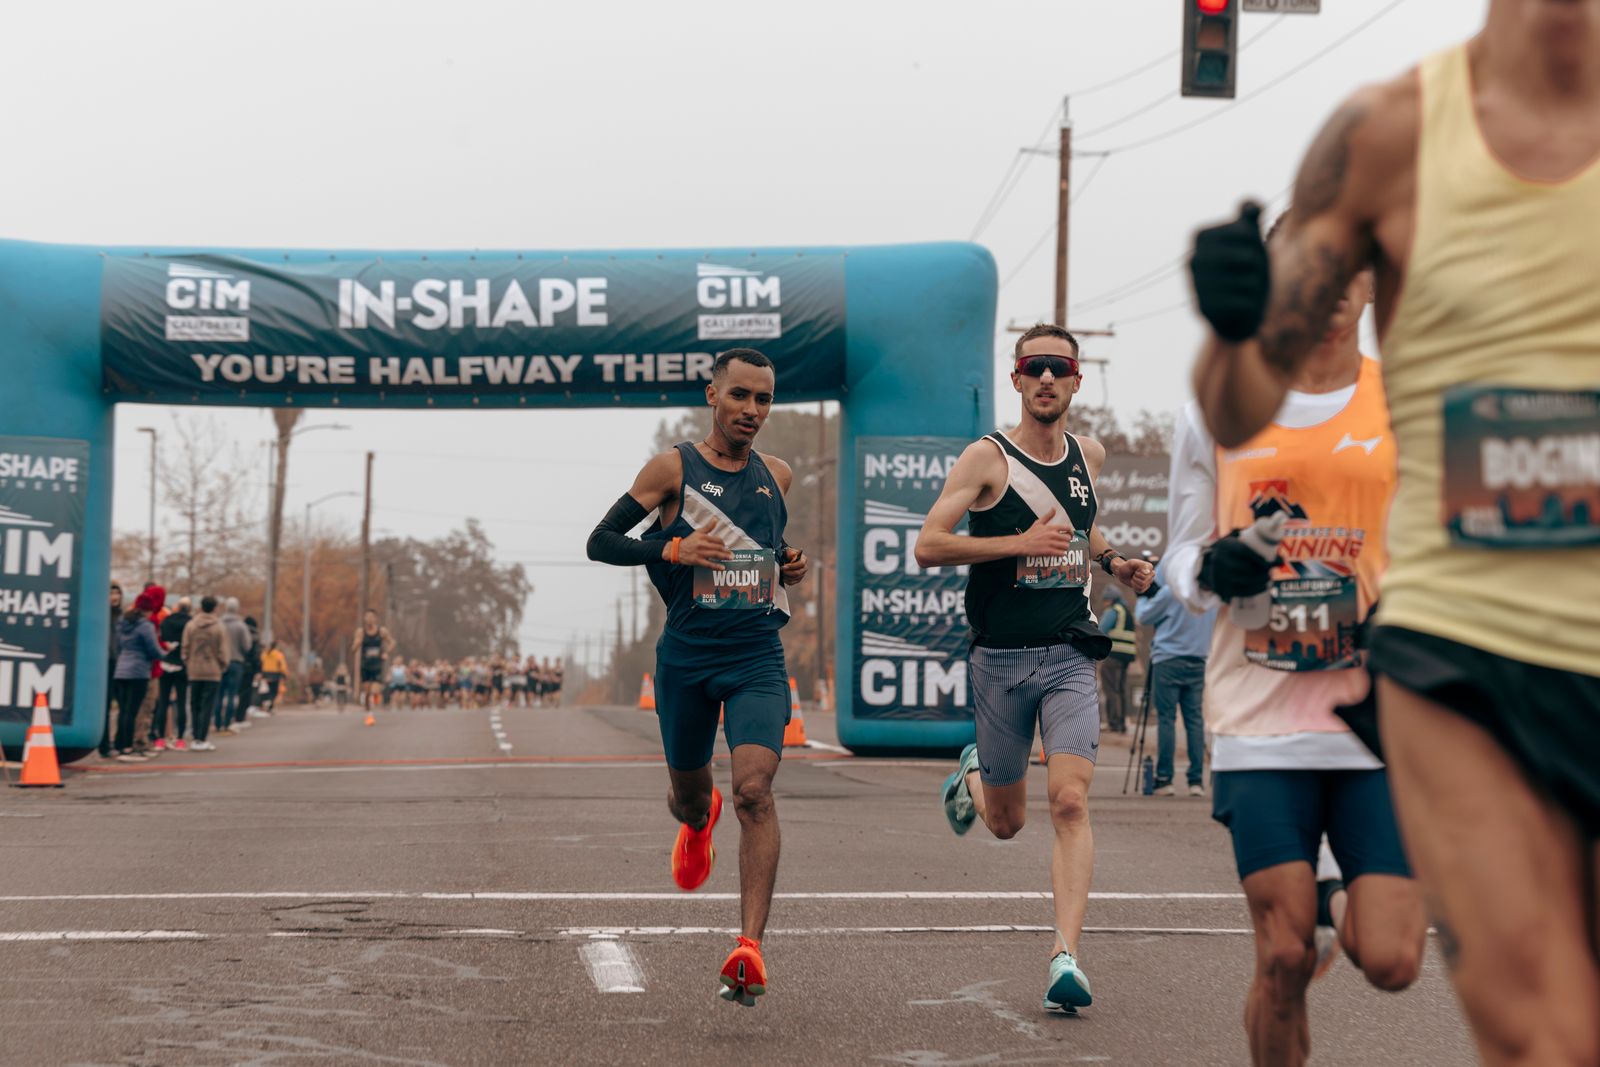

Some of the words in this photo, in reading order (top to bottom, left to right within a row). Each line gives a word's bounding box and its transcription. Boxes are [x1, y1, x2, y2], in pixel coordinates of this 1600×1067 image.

[166, 278, 250, 310] CIM
[338, 277, 608, 330] IN-SHAPE
[697, 276, 781, 308] CIM
[191, 353, 356, 384] YOU'RE
[369, 355, 582, 385] HALFWAY
[593, 351, 726, 382] THER
[864, 453, 959, 479] IN-SHAP
[864, 480, 939, 490] FITNE
[0, 529, 74, 578] IM
[863, 528, 969, 575] CI
[712, 569, 760, 587] WOLDU
[1269, 603, 1330, 632] 511
[861, 658, 967, 707] CIM
